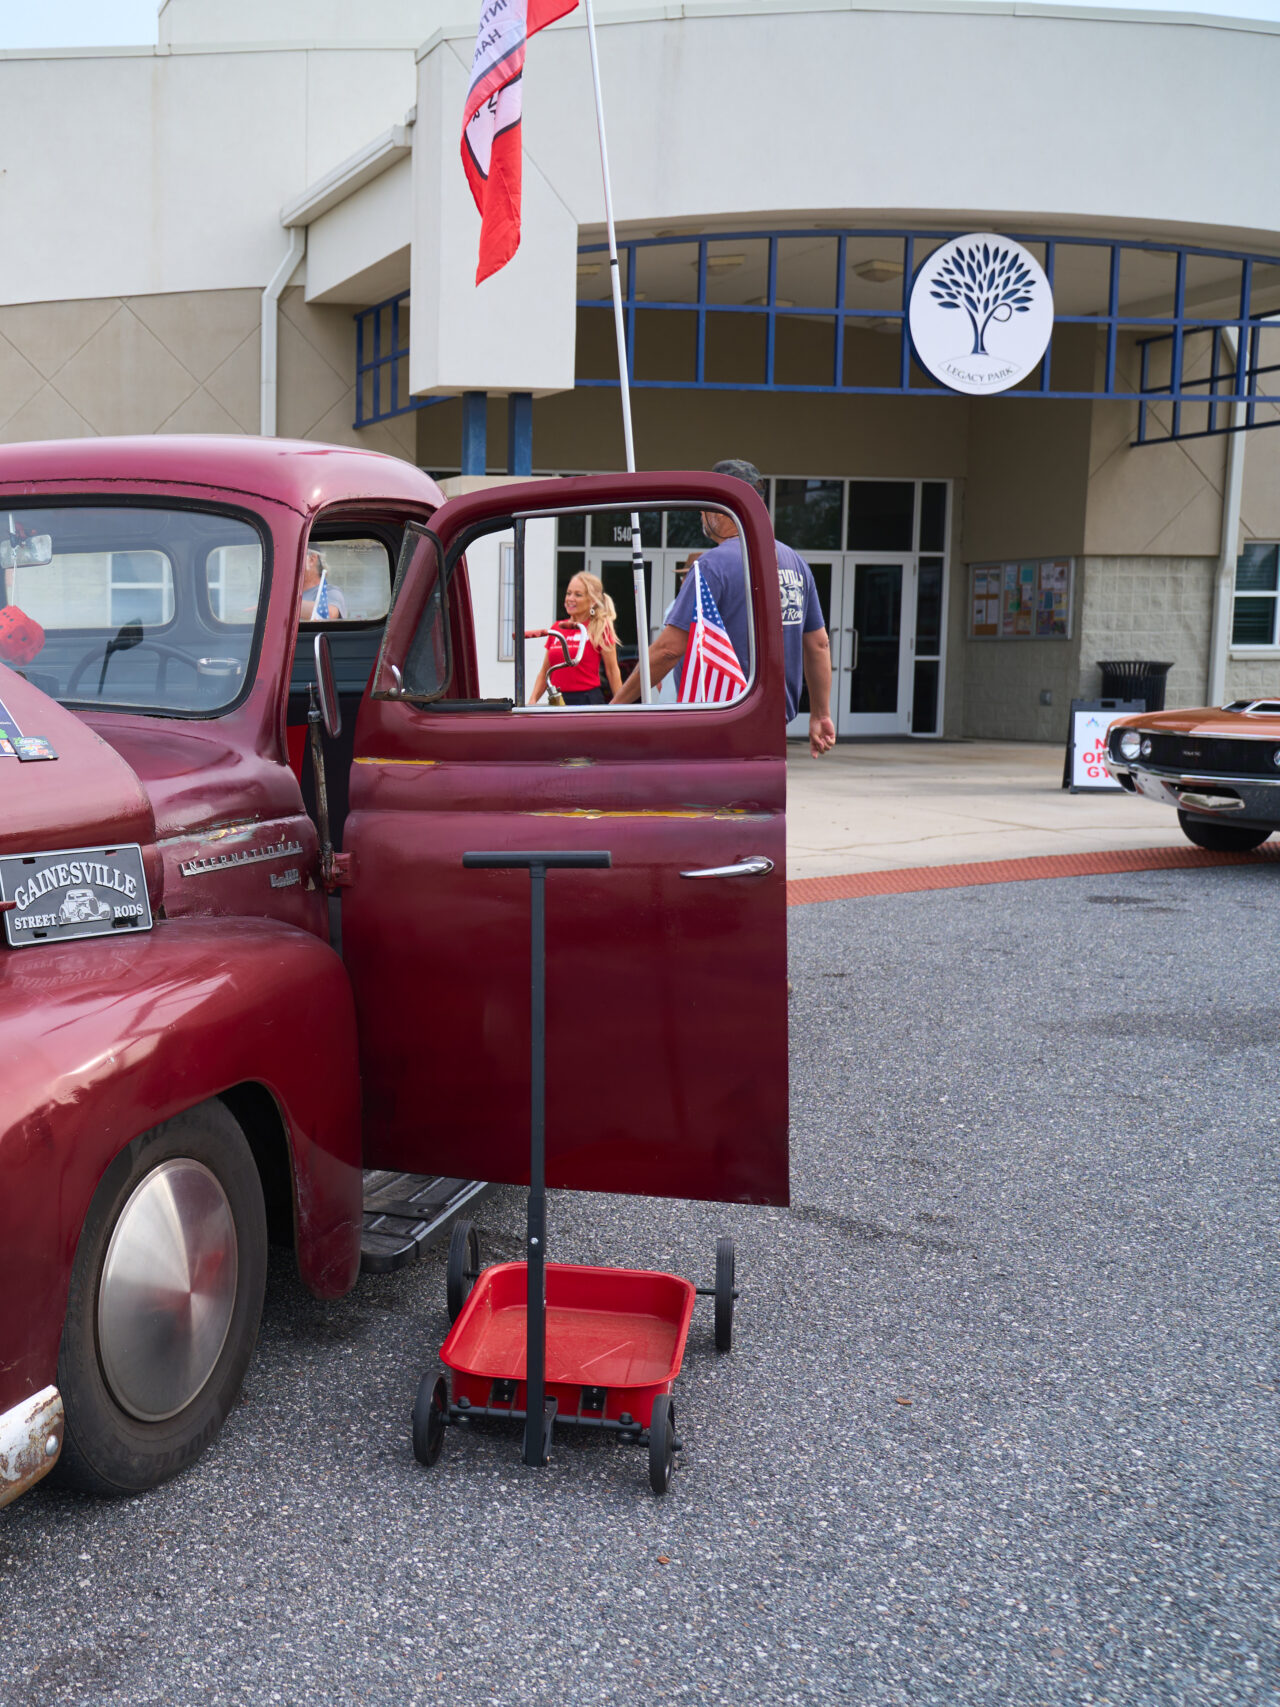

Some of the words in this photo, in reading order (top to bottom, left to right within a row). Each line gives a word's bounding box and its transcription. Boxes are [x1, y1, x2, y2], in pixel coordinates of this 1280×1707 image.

[946, 364, 984, 382] LEGACY
[987, 367, 1013, 381] PARK
[180, 840, 303, 875] INTERNATIONAL
[14, 861, 137, 911] GAINESVILLE
[14, 913, 57, 930] STREET
[113, 903, 144, 918] RODS
